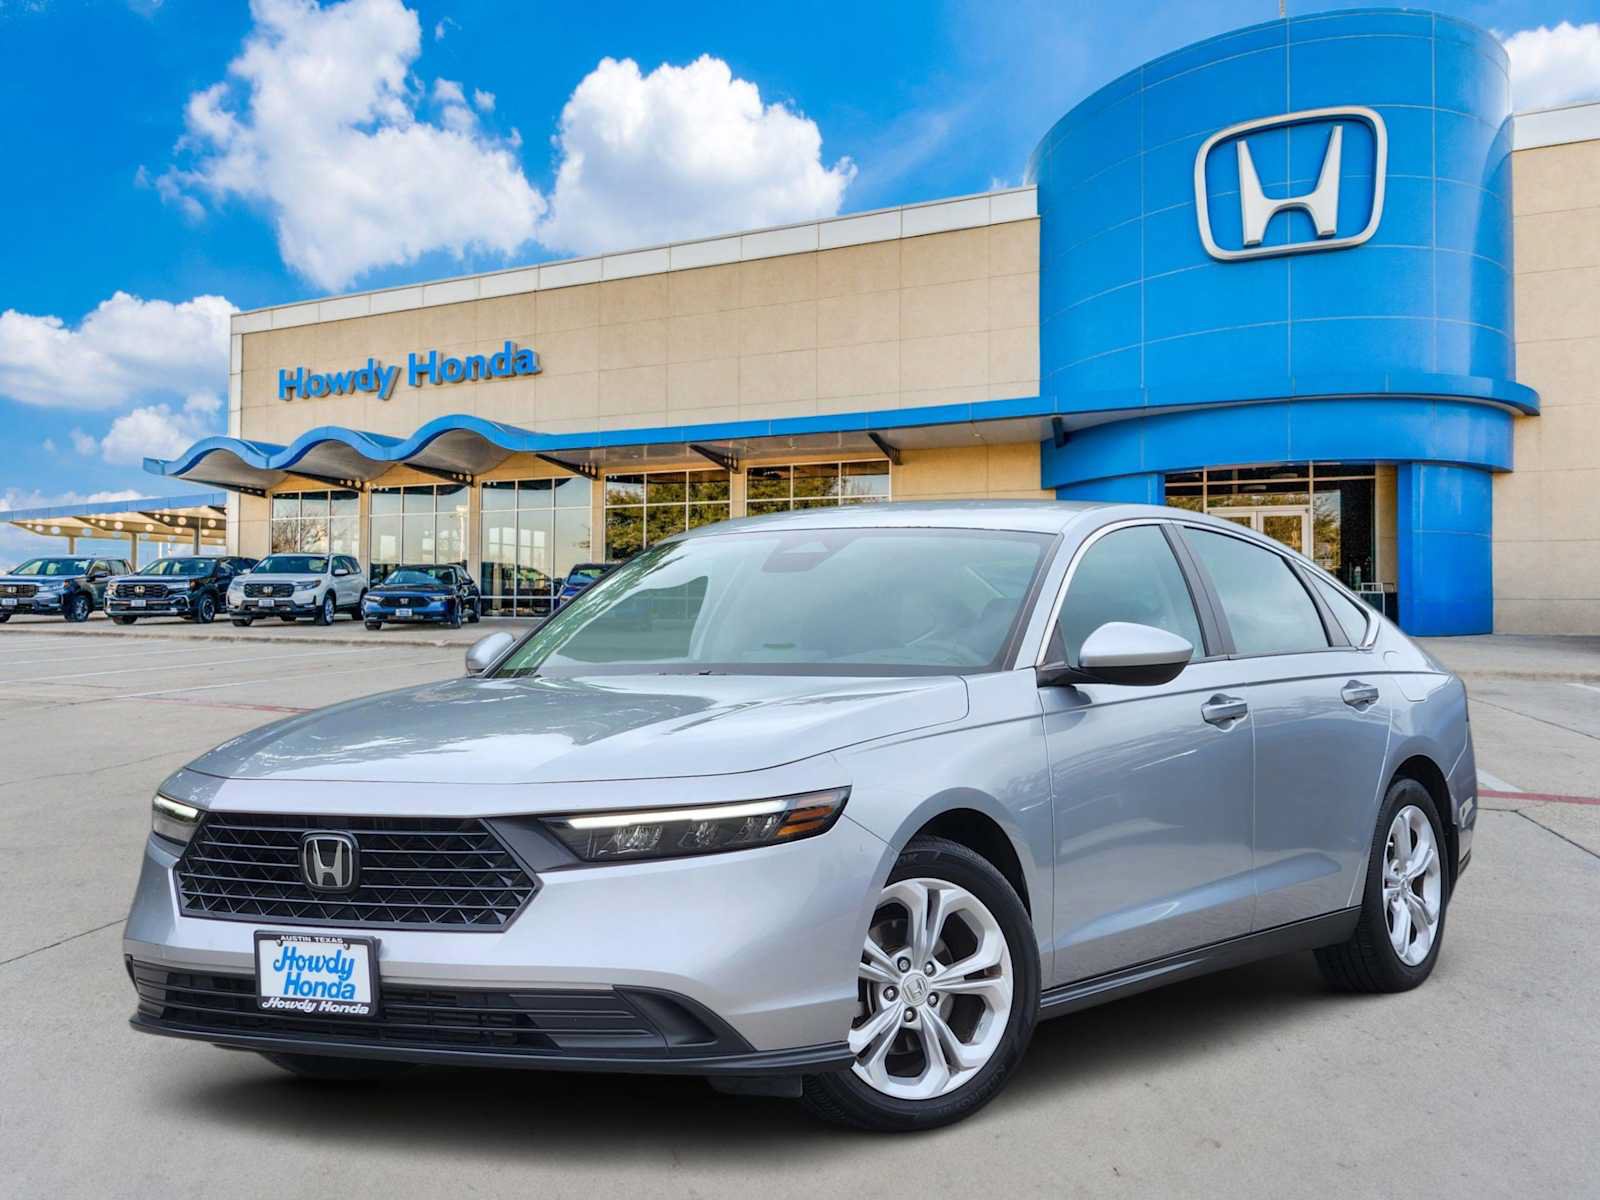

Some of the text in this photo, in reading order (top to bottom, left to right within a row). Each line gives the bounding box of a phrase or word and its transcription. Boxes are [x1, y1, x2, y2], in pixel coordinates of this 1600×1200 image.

[278, 341, 542, 401] Howdy Honda
[280, 935, 344, 945] AUSTIN TEXAS
[272, 946, 355, 981] Howdy
[283, 972, 356, 1000] Honda
[262, 997, 370, 1015] Howdy Honda
